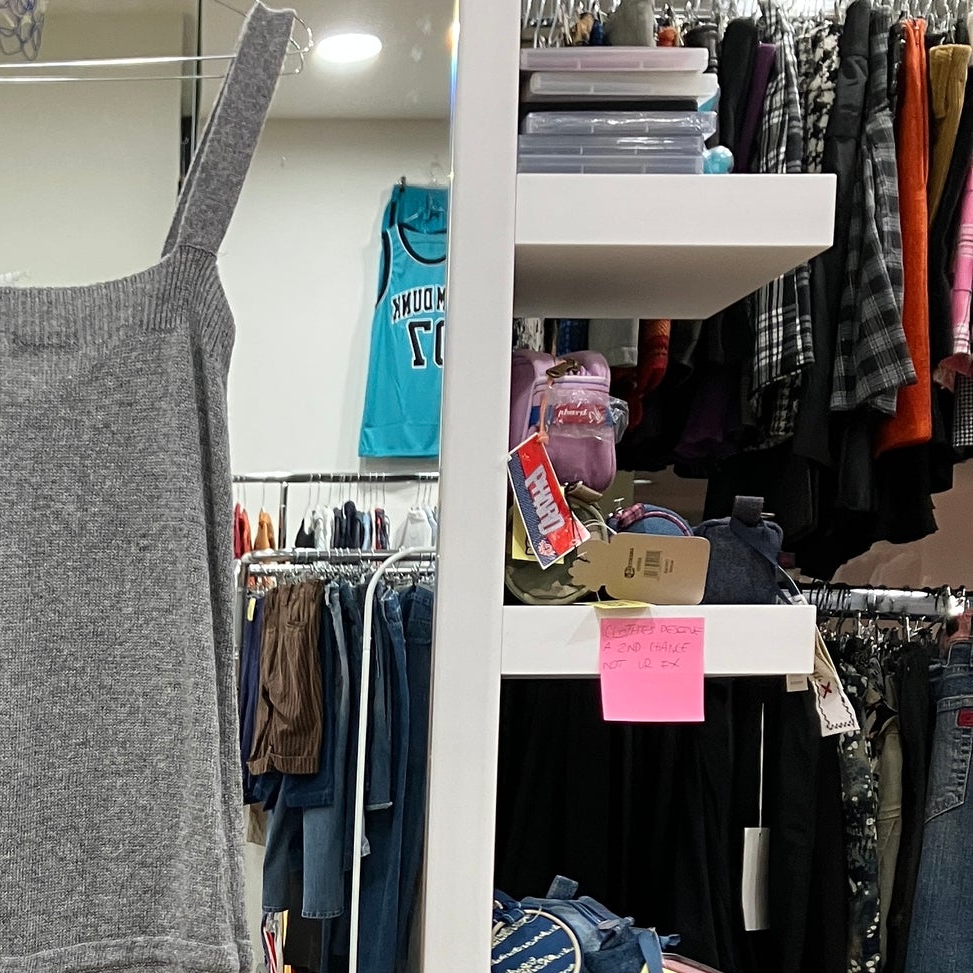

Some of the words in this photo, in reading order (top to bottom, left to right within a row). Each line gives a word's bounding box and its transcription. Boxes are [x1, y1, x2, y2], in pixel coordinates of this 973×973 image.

[525, 464, 565, 536] PHARD
[617, 642, 641, 653] 2ND
[603, 659, 627, 669] NOT
